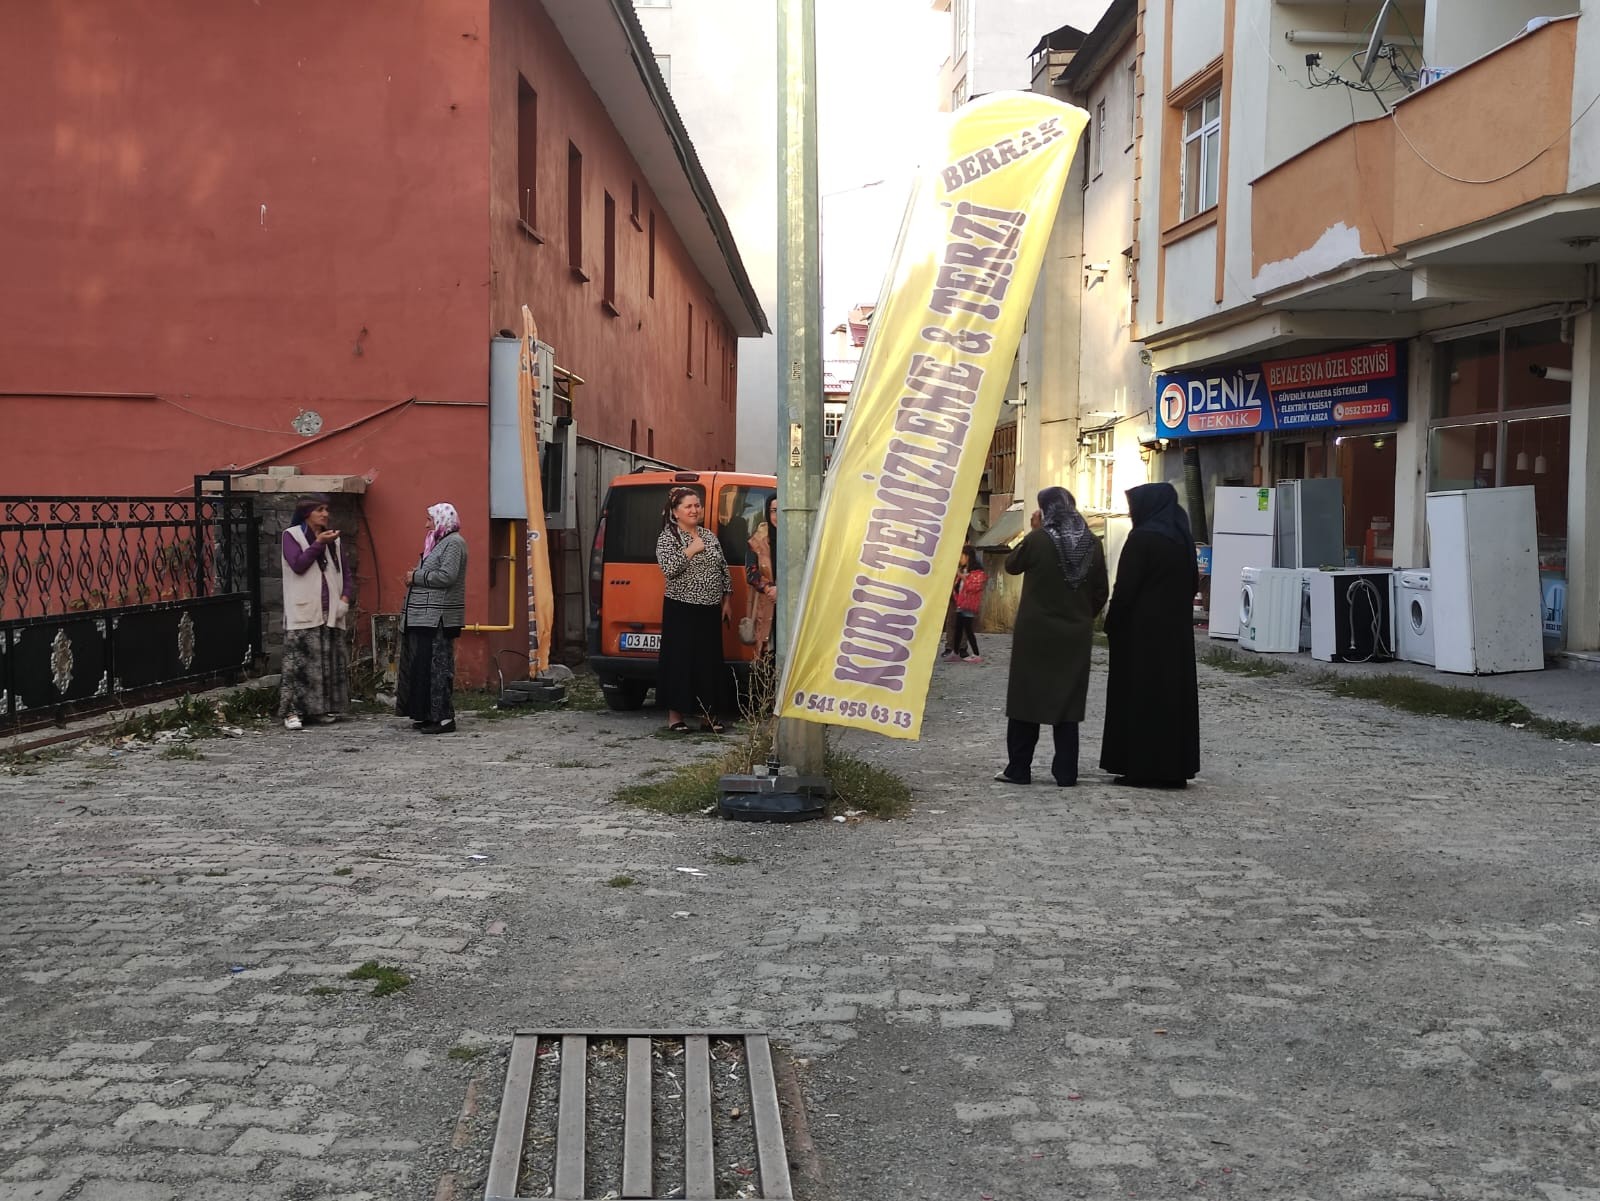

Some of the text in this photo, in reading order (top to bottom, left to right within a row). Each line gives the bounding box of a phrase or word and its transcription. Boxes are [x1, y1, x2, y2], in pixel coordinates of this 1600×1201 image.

[940, 117, 1064, 192] BERRAK
[1270, 349, 1389, 386] BEYAZ EŞYA ÖZEL SERVİSİ
[1187, 369, 1262, 413] DENİZ
[1278, 383, 1368, 402] GÜVENLİK KAMERA SİSTEMLERİ
[1281, 400, 1332, 413] ELEKTRİK TESİSAT
[1344, 406, 1360, 416] 0532
[1200, 412, 1249, 428] TEKNİK
[1284, 412, 1328, 424] ELEKTRİK ARIZA
[834, 201, 1026, 691] KURU TEMİZLEME & TERZİ
[627, 634, 641, 647] 03
[794, 691, 911, 729] 0 541 958 63 13
